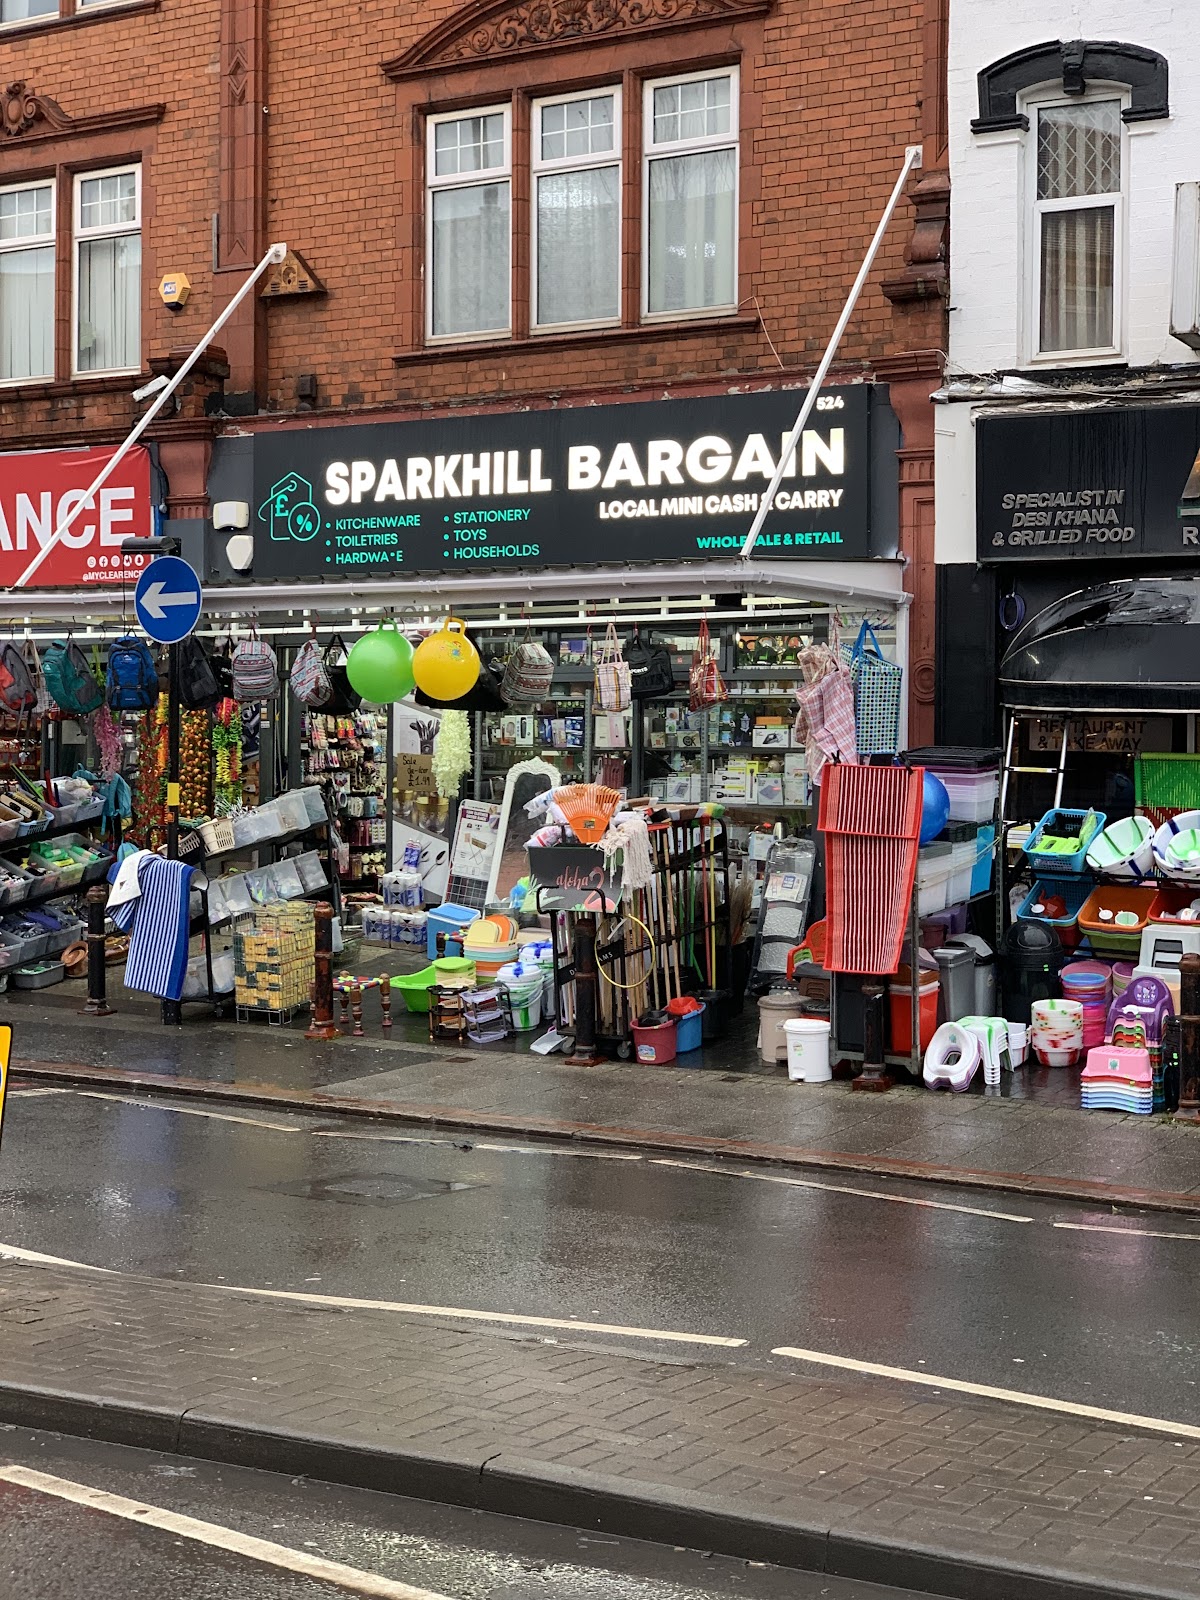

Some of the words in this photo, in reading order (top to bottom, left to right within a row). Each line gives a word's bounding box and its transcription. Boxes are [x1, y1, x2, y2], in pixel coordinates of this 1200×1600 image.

[816, 396, 844, 411] 524
[325, 448, 552, 505] SPARKHILL
[568, 427, 844, 490] BARGAIN
[599, 498, 659, 519] LOCAL
[660, 496, 703, 516] MINI
[705, 493, 758, 514] CASH
[771, 488, 844, 511] CARRY
[1001, 490, 1105, 509] SPECIALIST
[1105, 489, 1125, 506] IN
[335, 514, 421, 531] KITCHENWARE
[453, 508, 531, 525] STATIONERY
[1011, 511, 1053, 528] DESI
[1054, 508, 1119, 526] KHANA
[335, 532, 398, 548] TOILETRIES
[453, 528, 487, 542] TOYS
[696, 532, 781, 549] WHOLEALE
[783, 533, 793, 547] &
[794, 531, 844, 546] RETAIL
[991, 531, 1005, 547] &
[1008, 528, 1083, 547] GRILLED
[1085, 526, 1136, 544] FOOD
[335, 550, 403, 565] HARDWAE
[453, 543, 540, 560] HOUSEHOLDS
[556, 865, 589, 890] aloha
